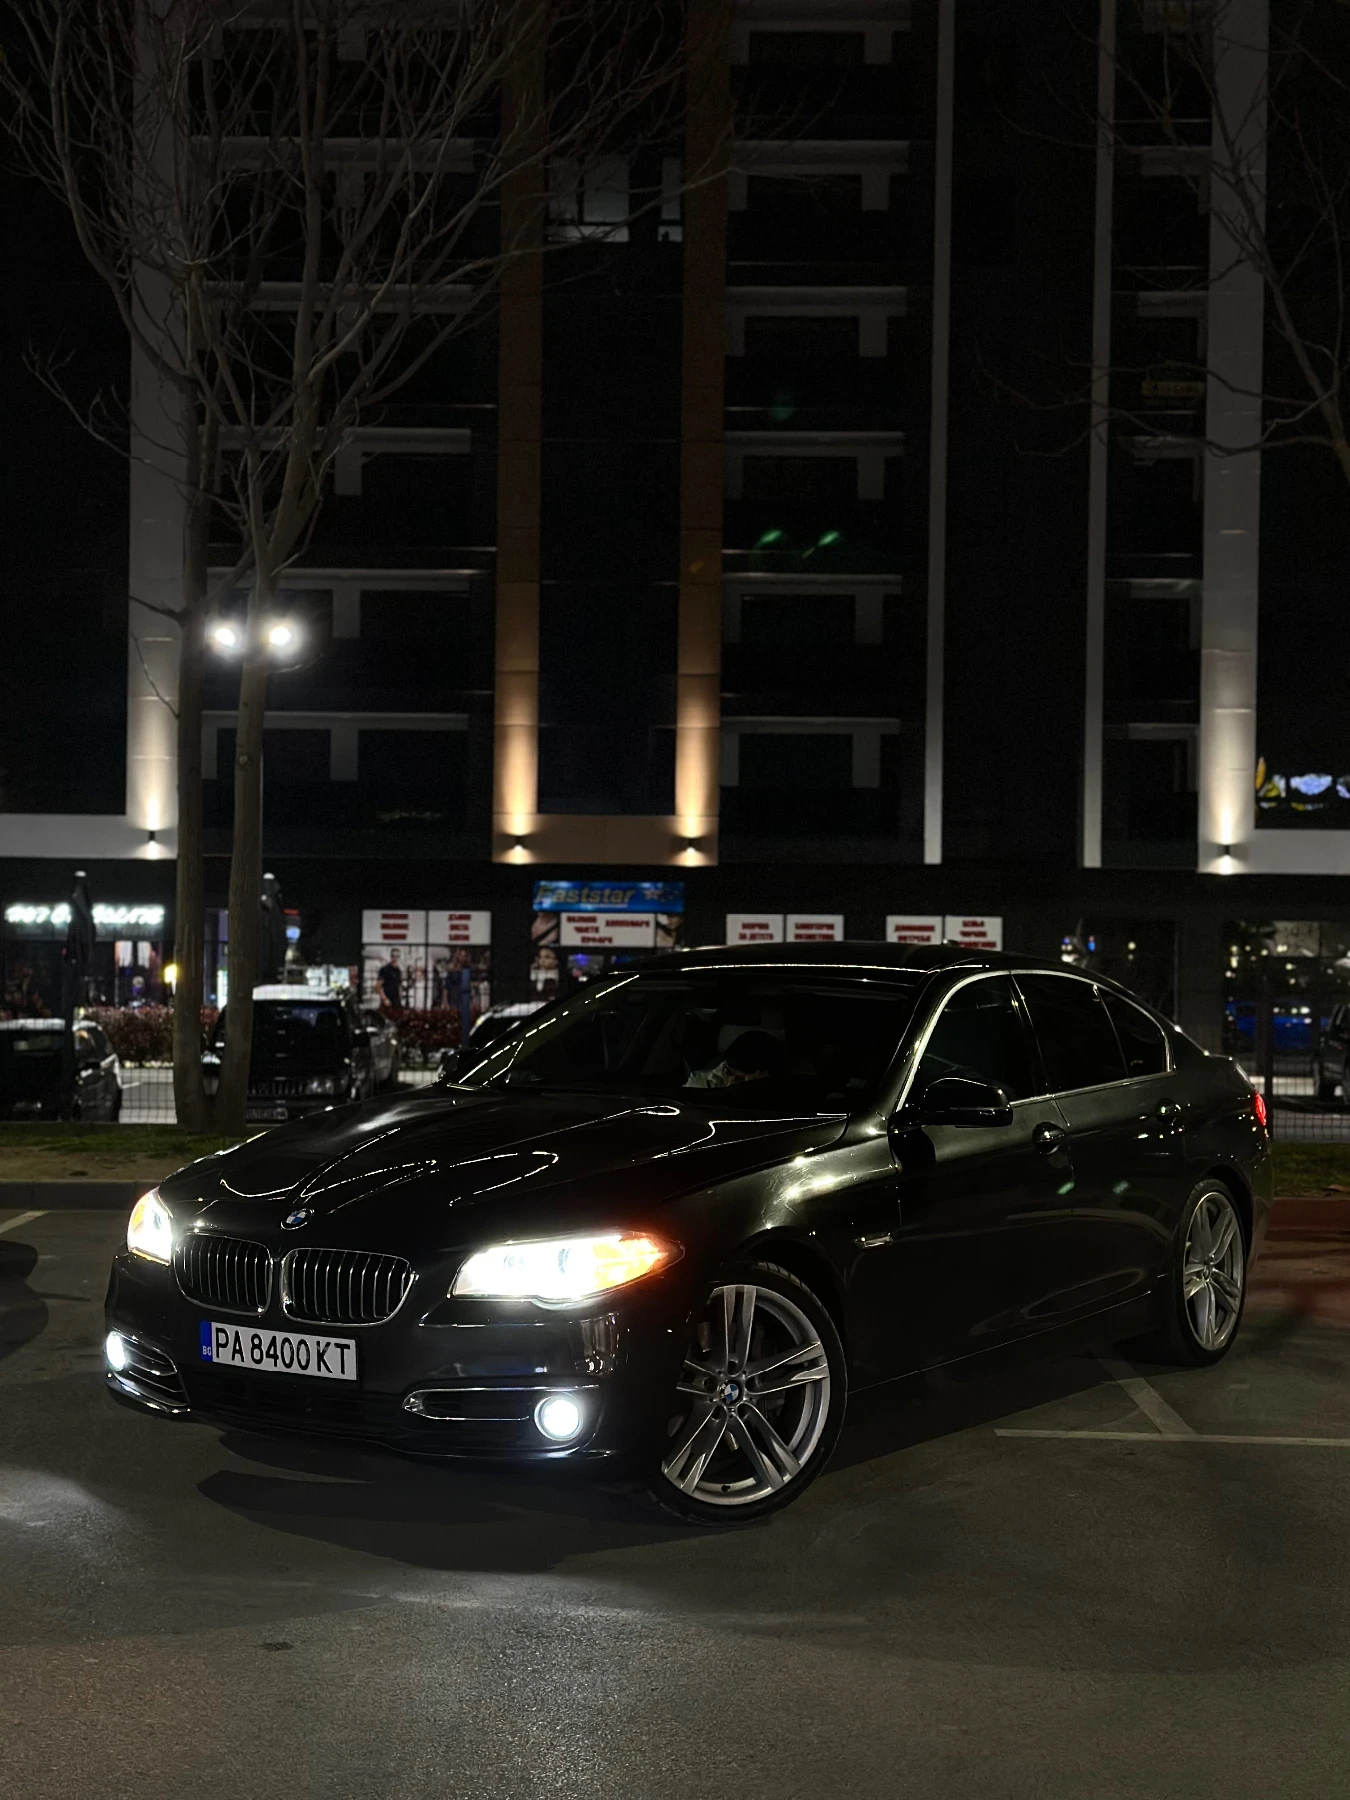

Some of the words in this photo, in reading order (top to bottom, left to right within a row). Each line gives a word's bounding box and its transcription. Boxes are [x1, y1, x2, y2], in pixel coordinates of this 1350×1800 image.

[535, 886, 636, 904] Faststar
[202, 1345, 212, 1356] BG
[215, 1327, 245, 1363] PA
[250, 1333, 311, 1371] 8400
[316, 1340, 351, 1375] KT
